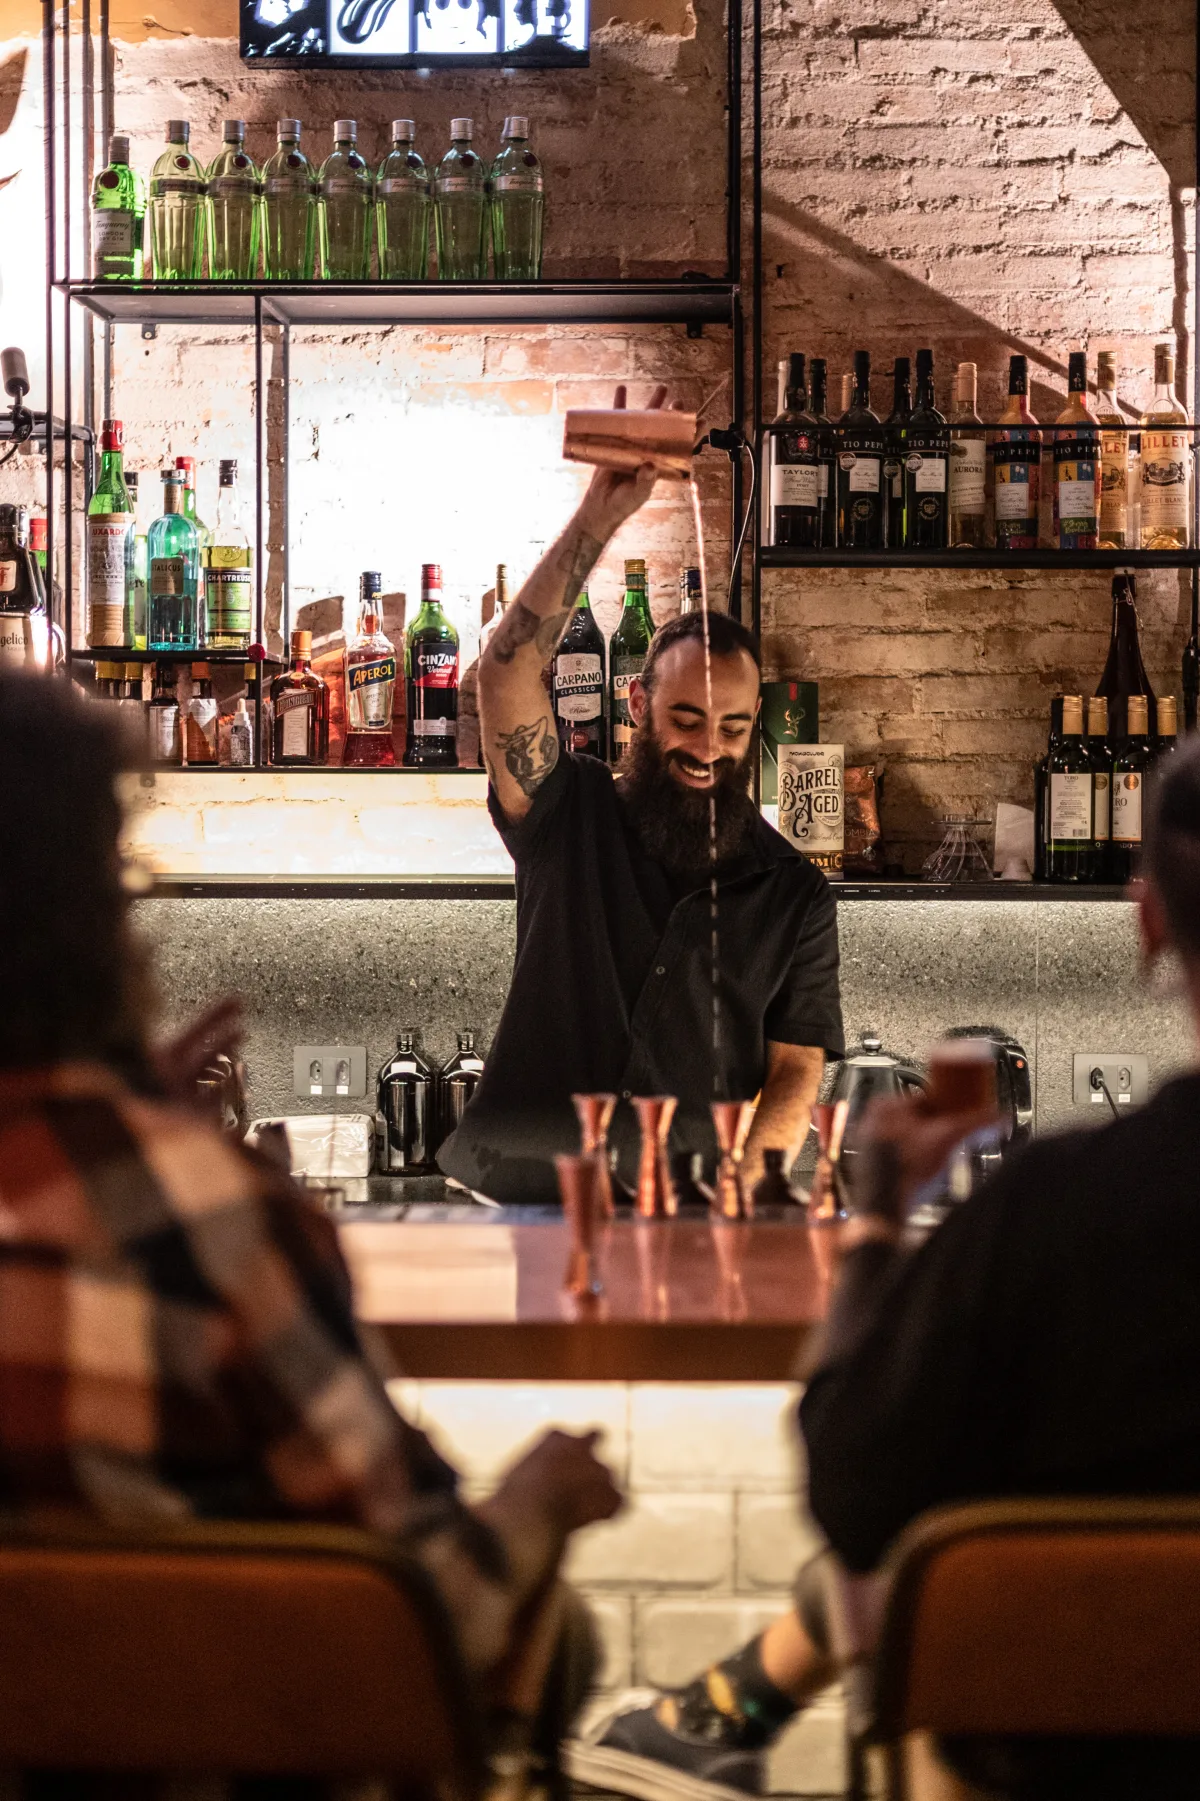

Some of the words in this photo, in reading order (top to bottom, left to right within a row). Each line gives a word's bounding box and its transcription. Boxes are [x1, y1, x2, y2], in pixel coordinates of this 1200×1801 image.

[1102, 442, 1127, 454] LET
[1142, 435, 1185, 450] LILLET
[954, 465, 983, 474] AURORA
[152, 564, 181, 573] TALICUS
[353, 665, 393, 686] APEROL
[557, 671, 602, 687] CARPANO
[560, 685, 596, 696] CLASSICO
[780, 768, 838, 812] BARREL
[1113, 797, 1128, 807] RO
